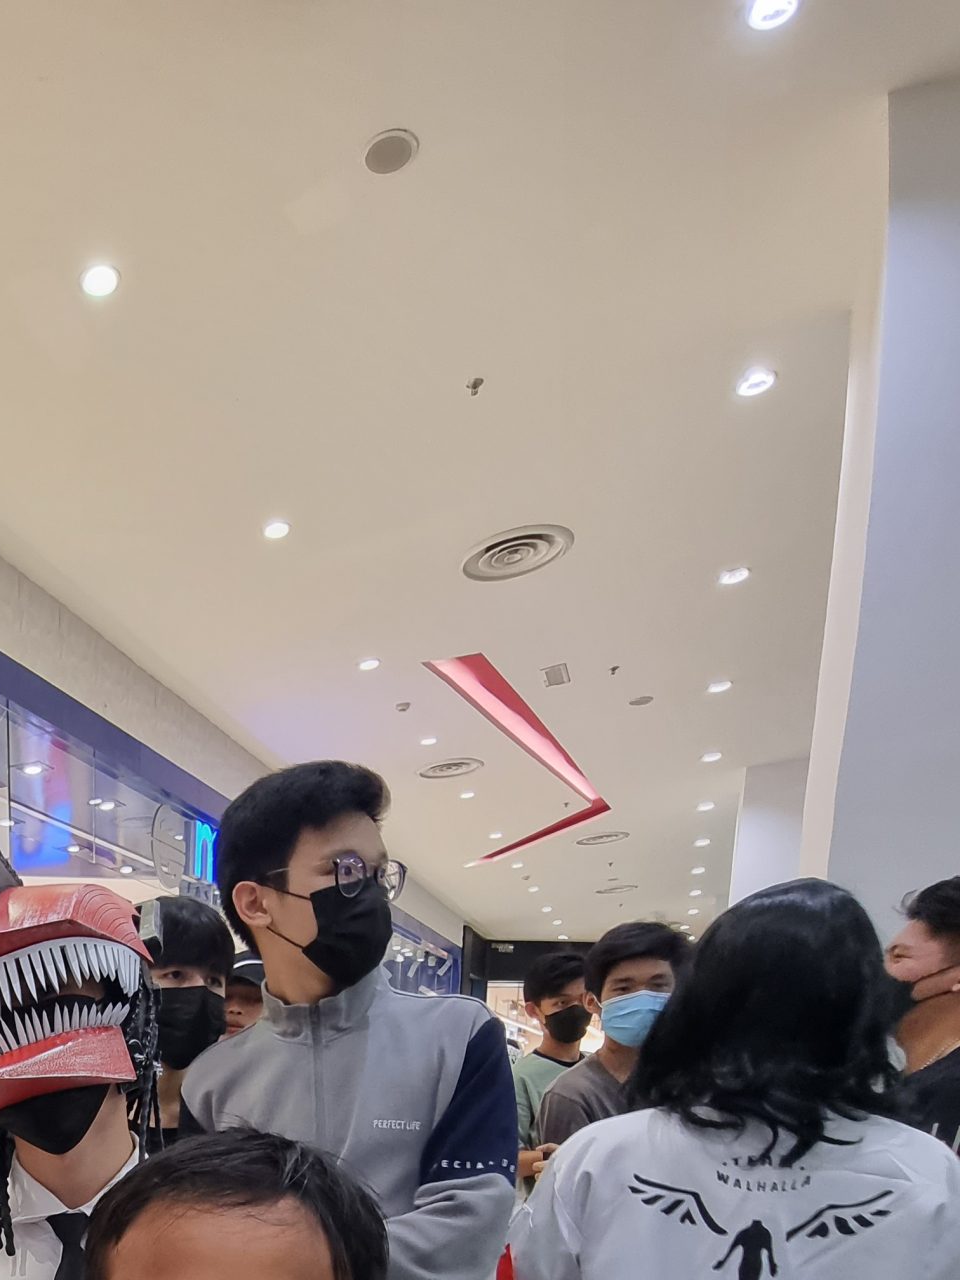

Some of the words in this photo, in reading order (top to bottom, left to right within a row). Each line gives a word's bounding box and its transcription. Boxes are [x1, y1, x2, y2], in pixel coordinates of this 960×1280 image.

[372, 1119, 405, 1130] PERFECT
[406, 1120, 421, 1130] LIFE
[716, 1169, 811, 1193] WALHALLA
